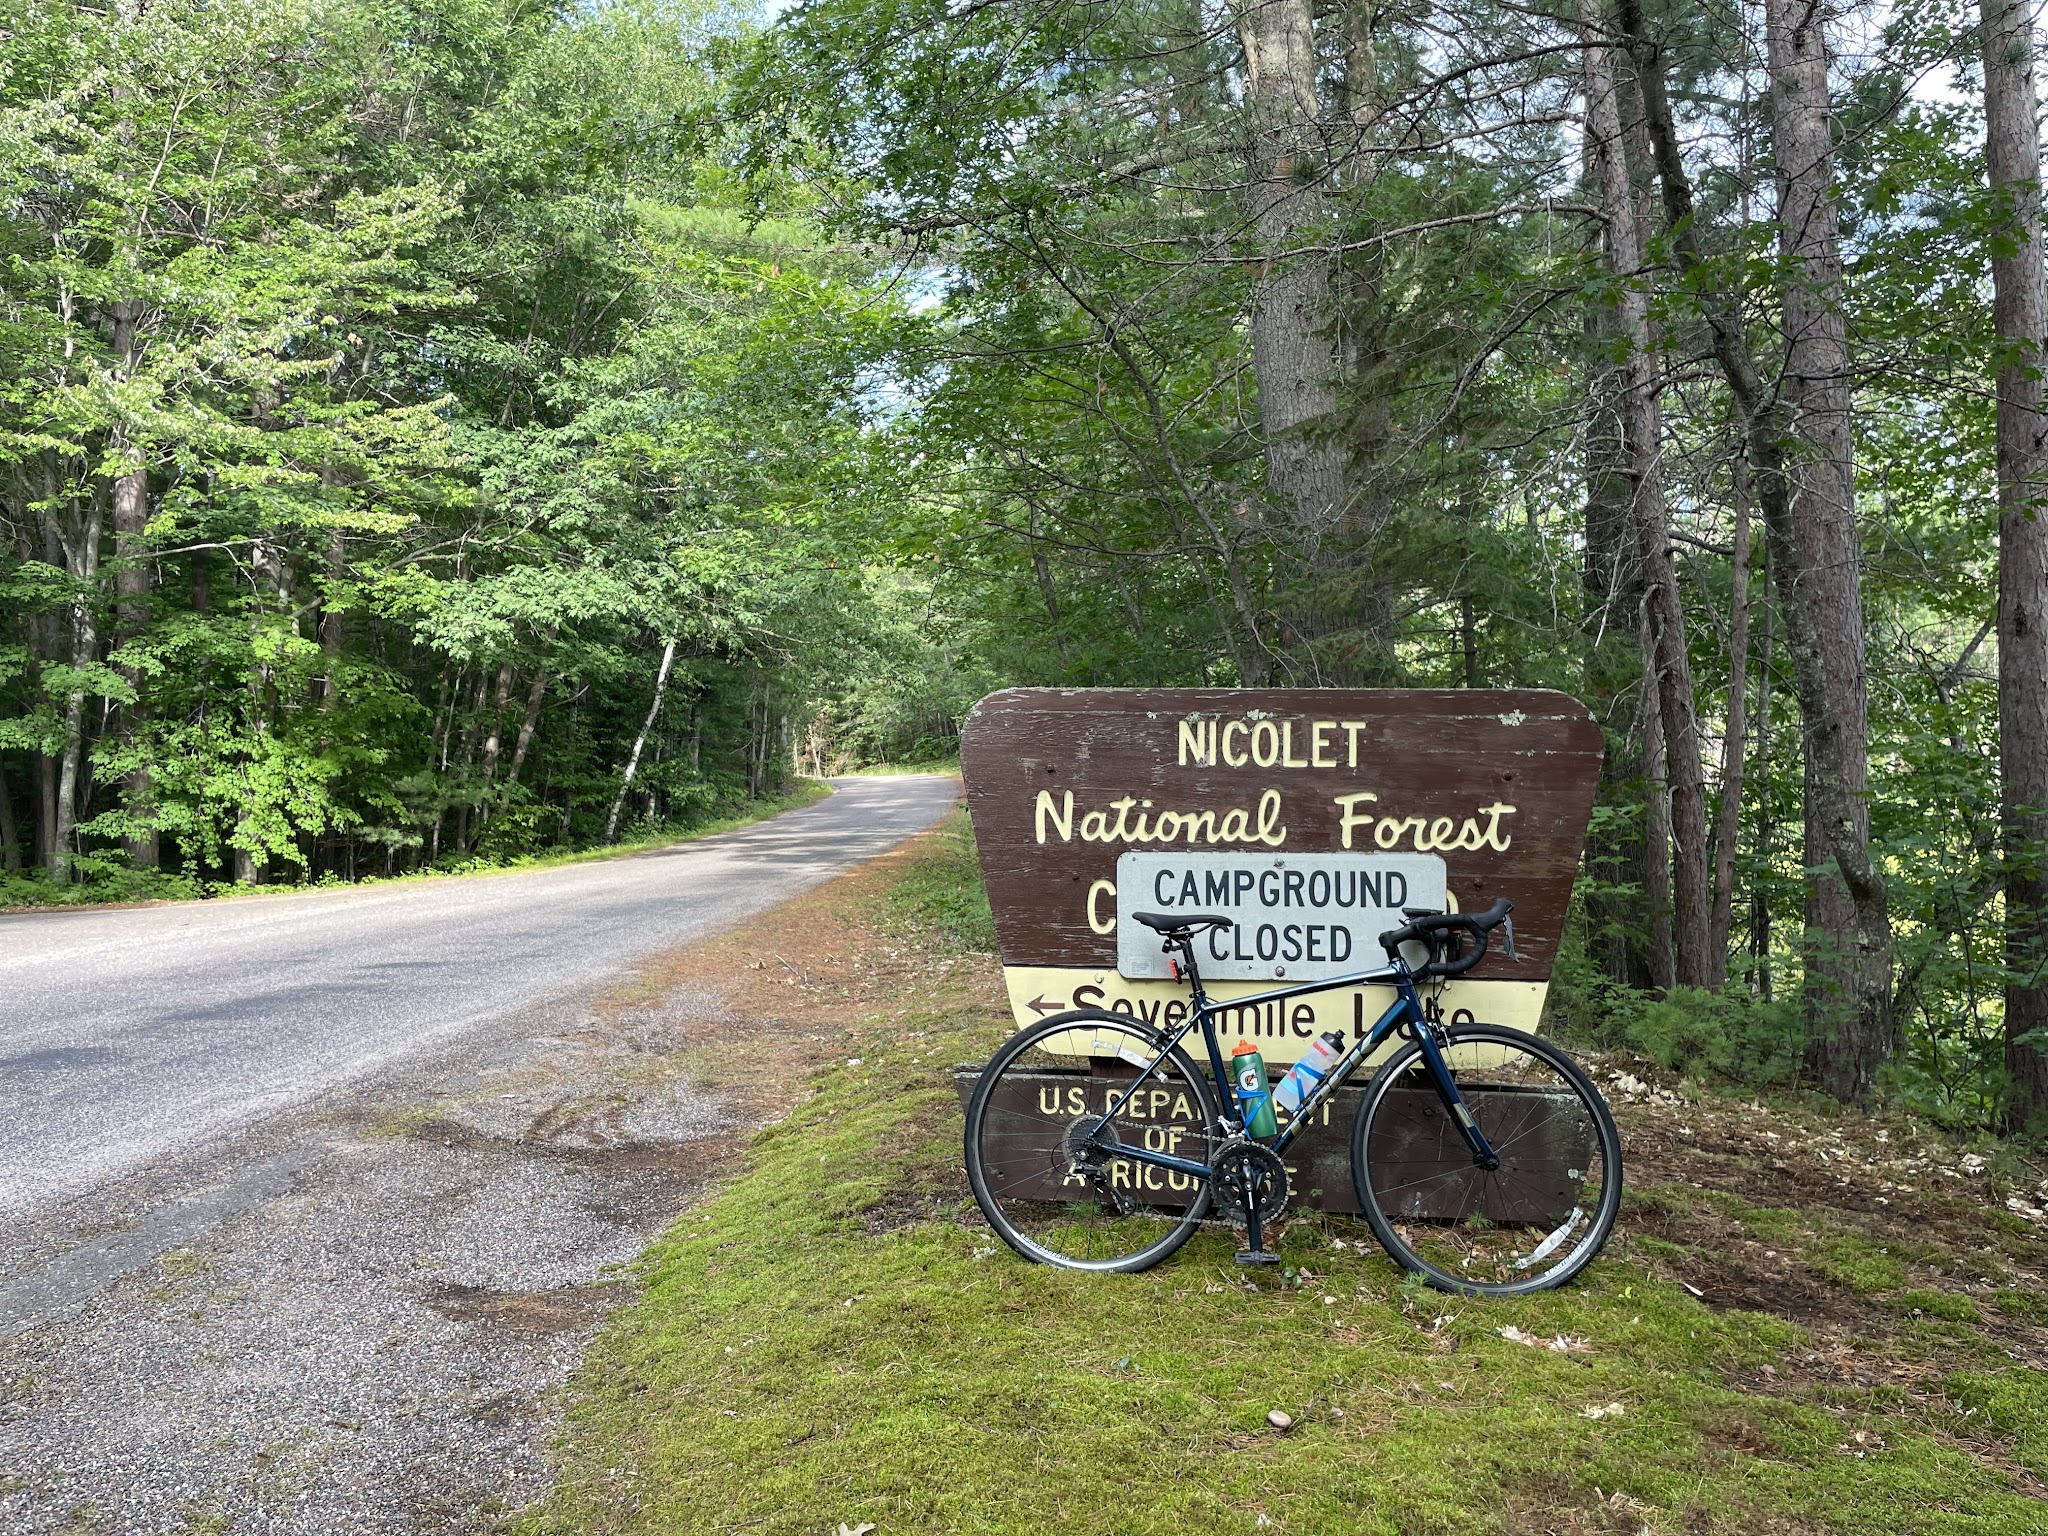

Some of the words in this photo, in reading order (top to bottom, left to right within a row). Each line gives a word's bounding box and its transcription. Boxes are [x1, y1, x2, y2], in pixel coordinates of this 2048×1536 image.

[1177, 720, 1367, 768] NICOLET
[1034, 788, 1287, 845] National
[1333, 791, 1518, 852] Forest
[1154, 869, 1408, 908] CAMPGROUND
[1209, 924, 1353, 963] CLOSED
[1073, 984, 1316, 1038] Svemile
[1039, 1086, 1091, 1116] U.S.
[1105, 1088, 1336, 1126] DEPAET
[1281, 1031, 1381, 1137] TREK
[1144, 1125, 1187, 1154] OF
